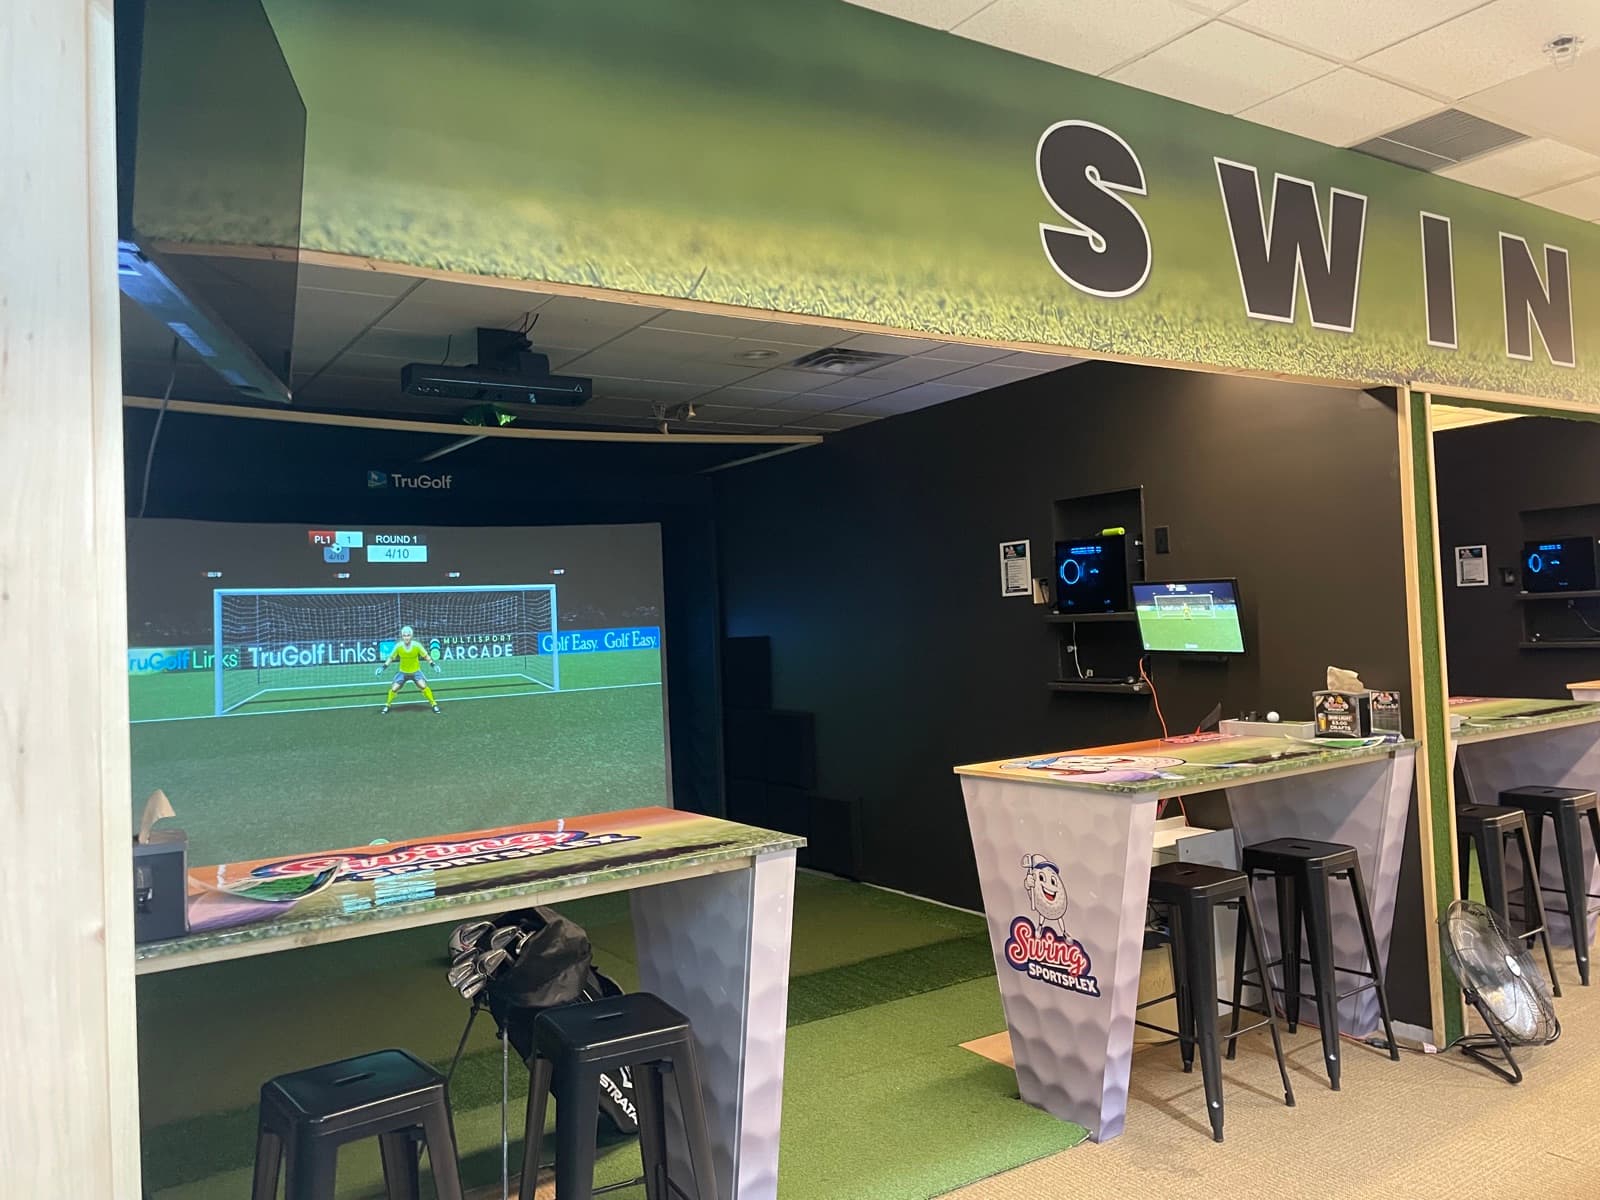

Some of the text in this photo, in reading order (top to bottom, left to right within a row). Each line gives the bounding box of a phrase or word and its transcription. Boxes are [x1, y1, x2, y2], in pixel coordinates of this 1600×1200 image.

[392, 474, 452, 488] TruGolf
[314, 535, 331, 544] PL1
[375, 534, 418, 544] ROUND 1
[385, 549, 410, 559] 4/10
[443, 635, 512, 644] MULTISPORT
[604, 629, 632, 649] Golf
[129, 649, 190, 672] ruGolf
[248, 641, 377, 667] TruGolf Links
[443, 644, 513, 661] ARCADE
[356, 835, 632, 879] SPORTSPLEX
[1009, 922, 1087, 977] Swing
[1028, 962, 1098, 994] SPORTSPLEX
